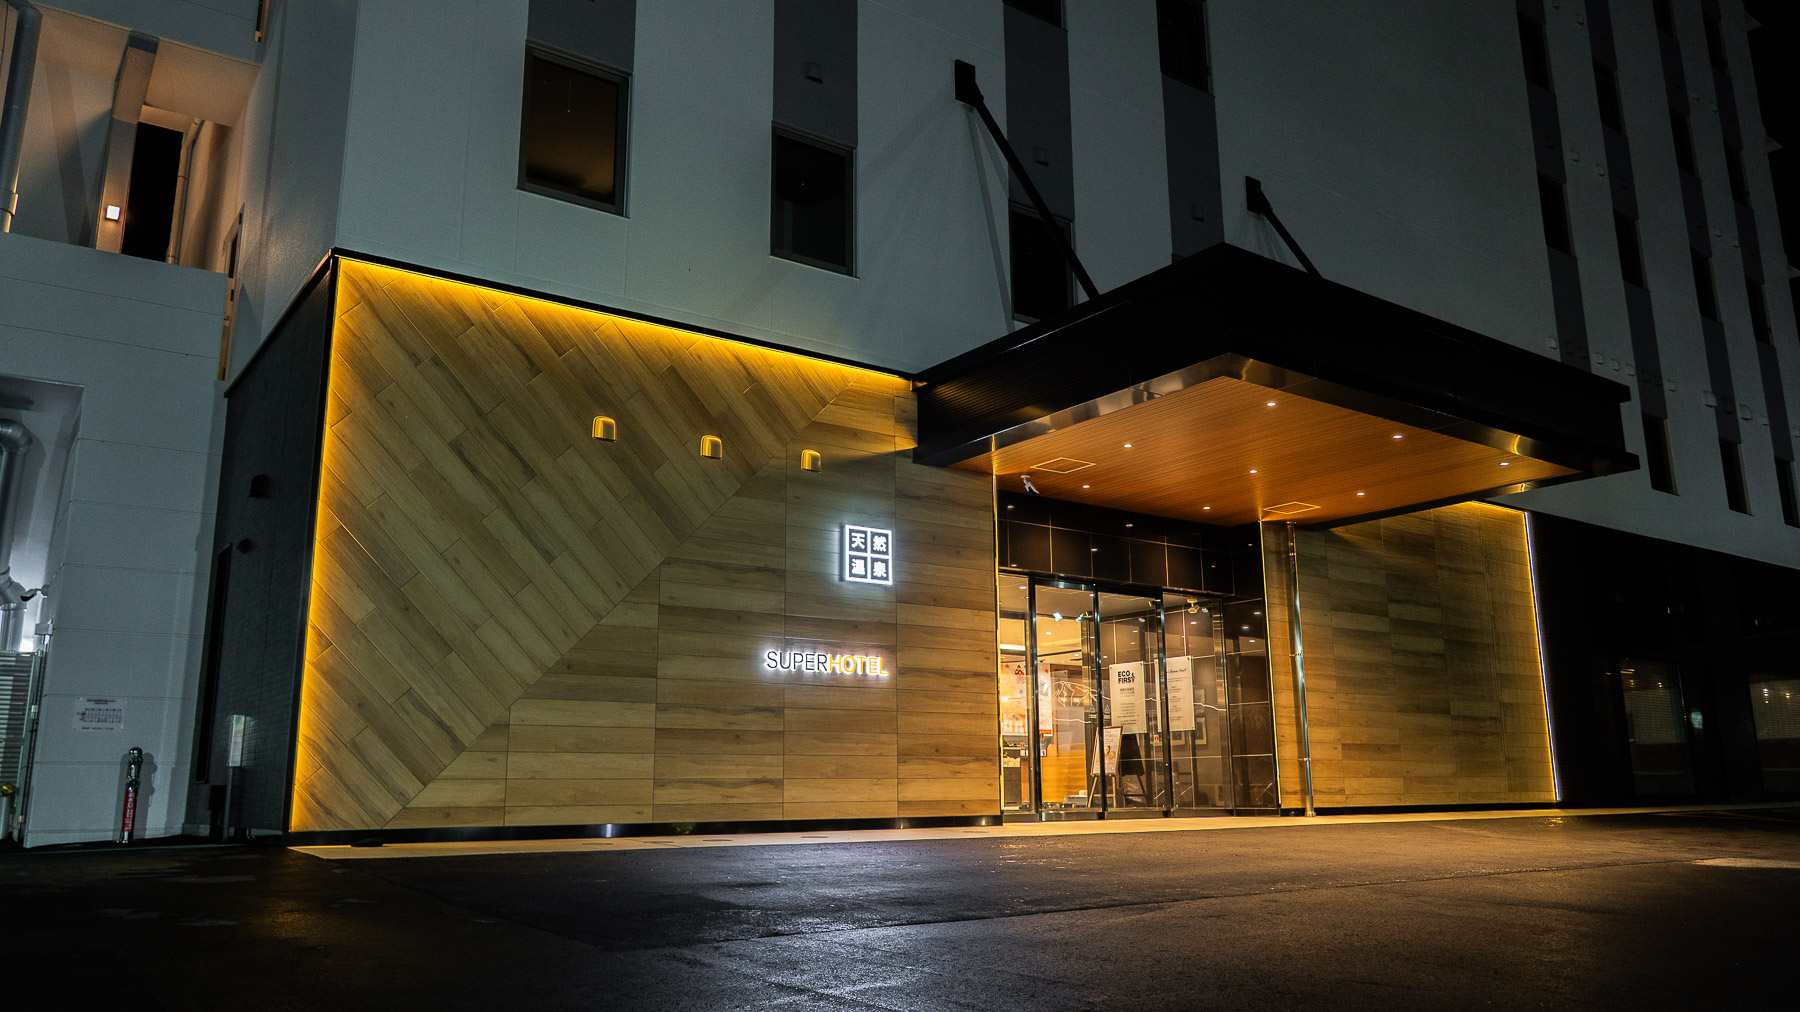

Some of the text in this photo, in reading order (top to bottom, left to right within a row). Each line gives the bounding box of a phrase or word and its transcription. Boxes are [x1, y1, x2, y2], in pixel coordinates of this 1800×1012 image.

[851, 533, 887, 552] 天然
[851, 558, 887, 577] 温泉
[1117, 676, 1136, 684] FIRST
